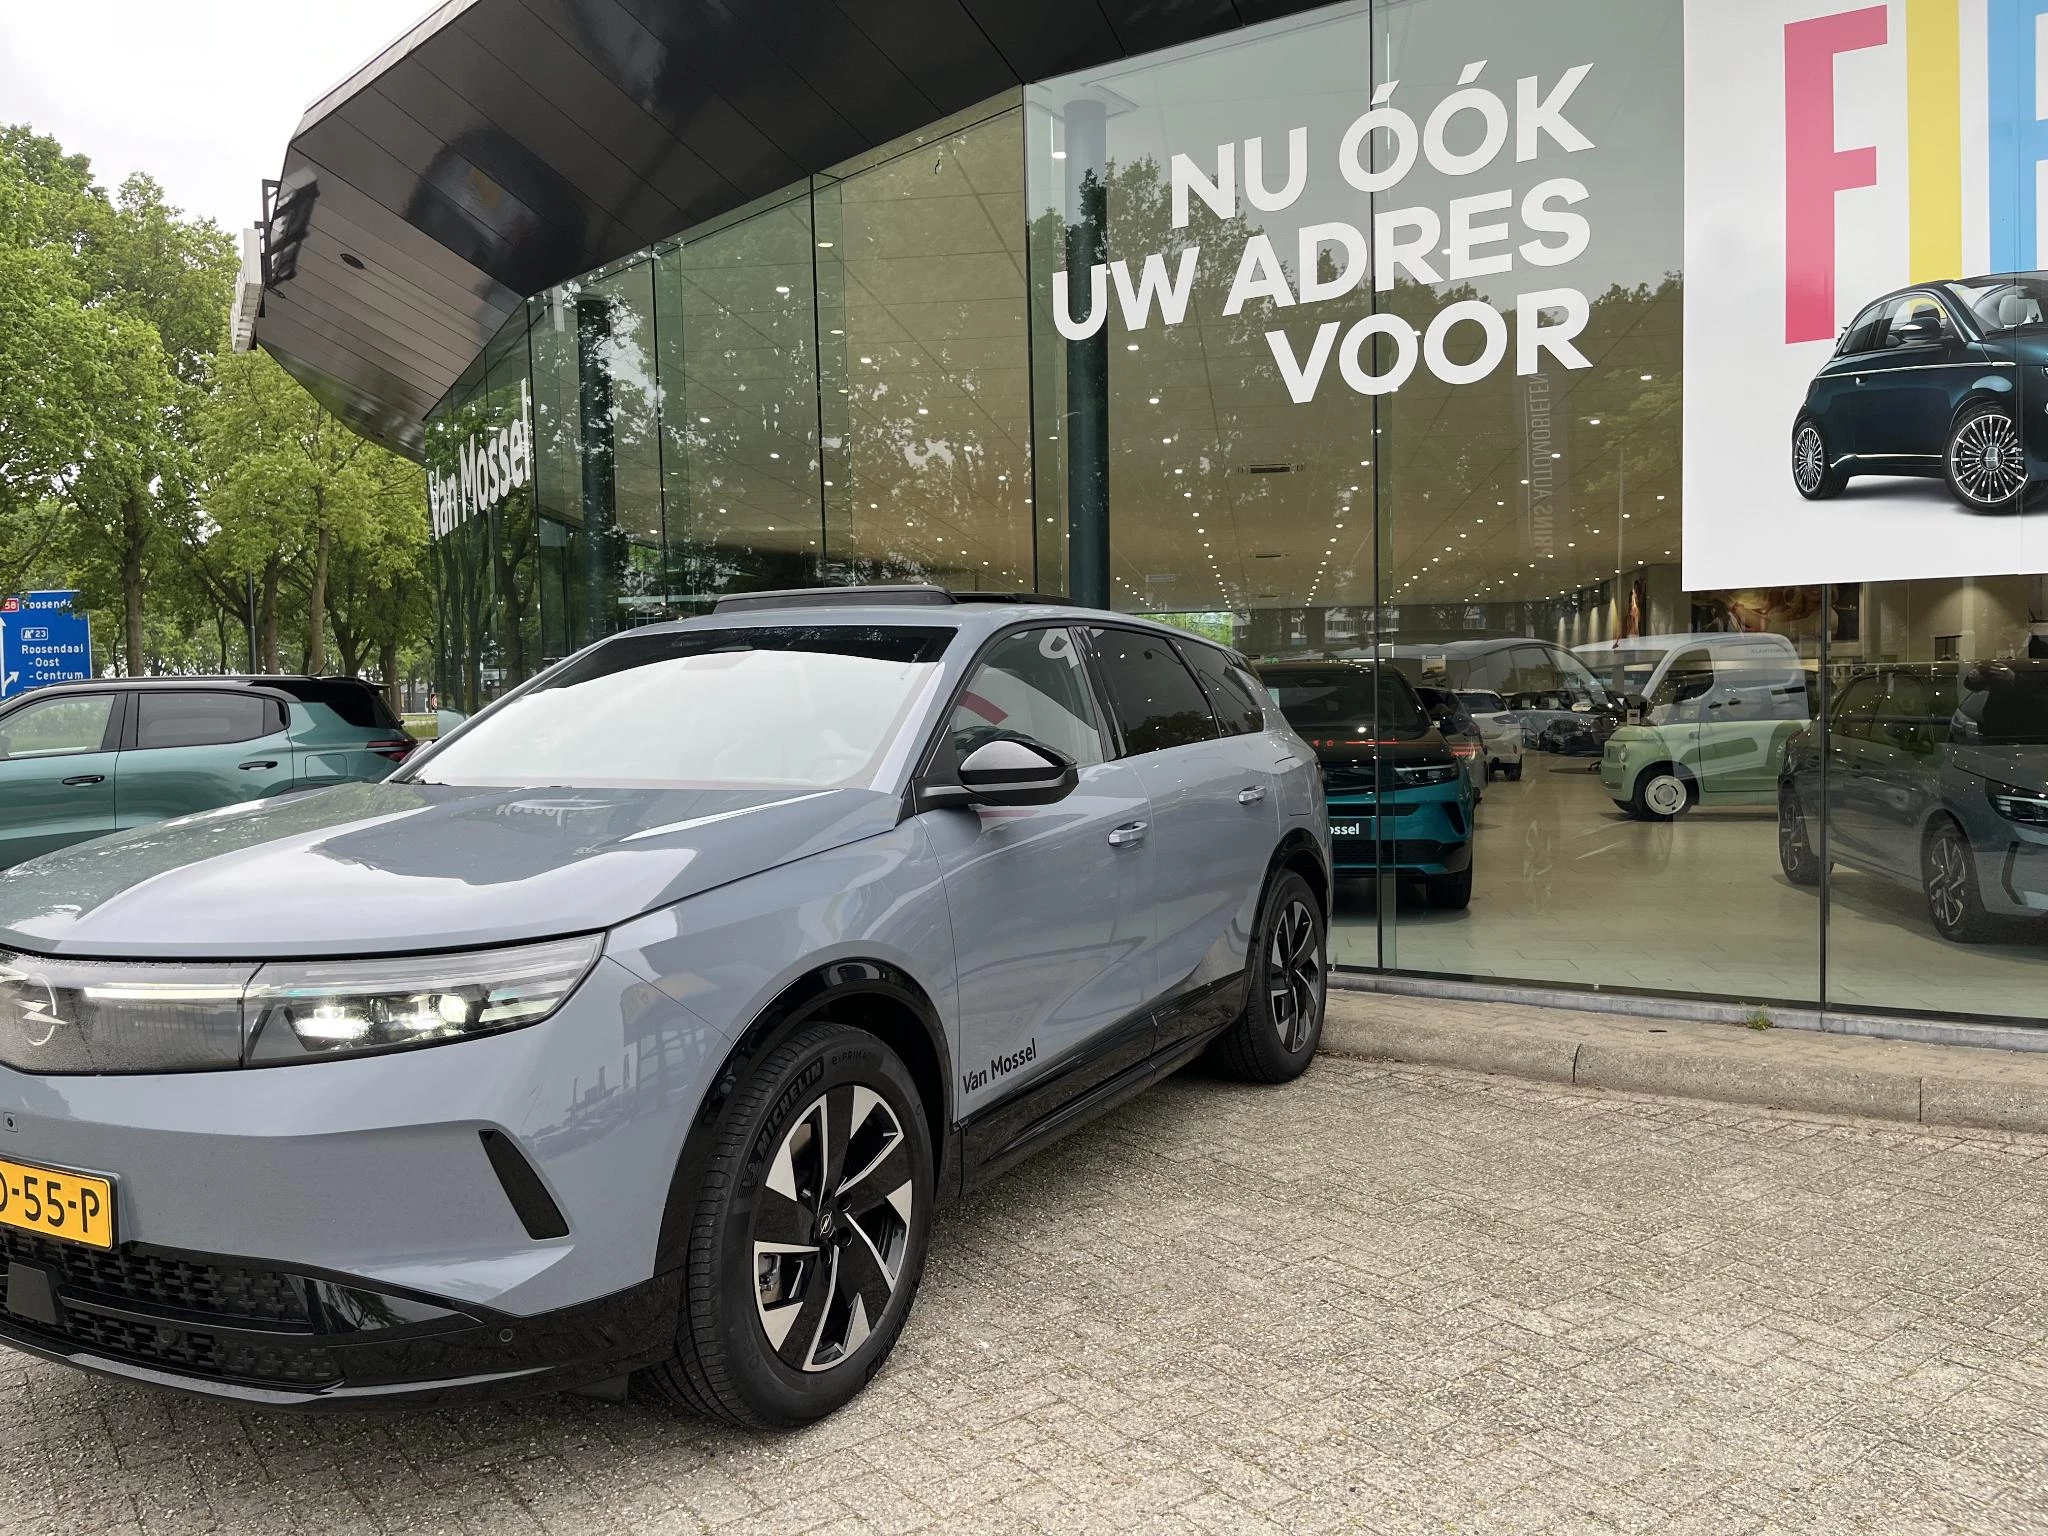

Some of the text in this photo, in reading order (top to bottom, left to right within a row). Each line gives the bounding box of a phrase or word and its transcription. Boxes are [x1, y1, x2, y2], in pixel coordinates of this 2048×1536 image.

[1171, 60, 1596, 228] NU ÓÓK
[1052, 177, 1592, 341] UW ADRES
[1264, 287, 1594, 404] VOOR
[428, 377, 531, 541] Van Mossel
[22, 644, 84, 655] Roosendaal
[756, 1060, 823, 1157] MICHELIN
[963, 1037, 1036, 1094] Van Mossel
